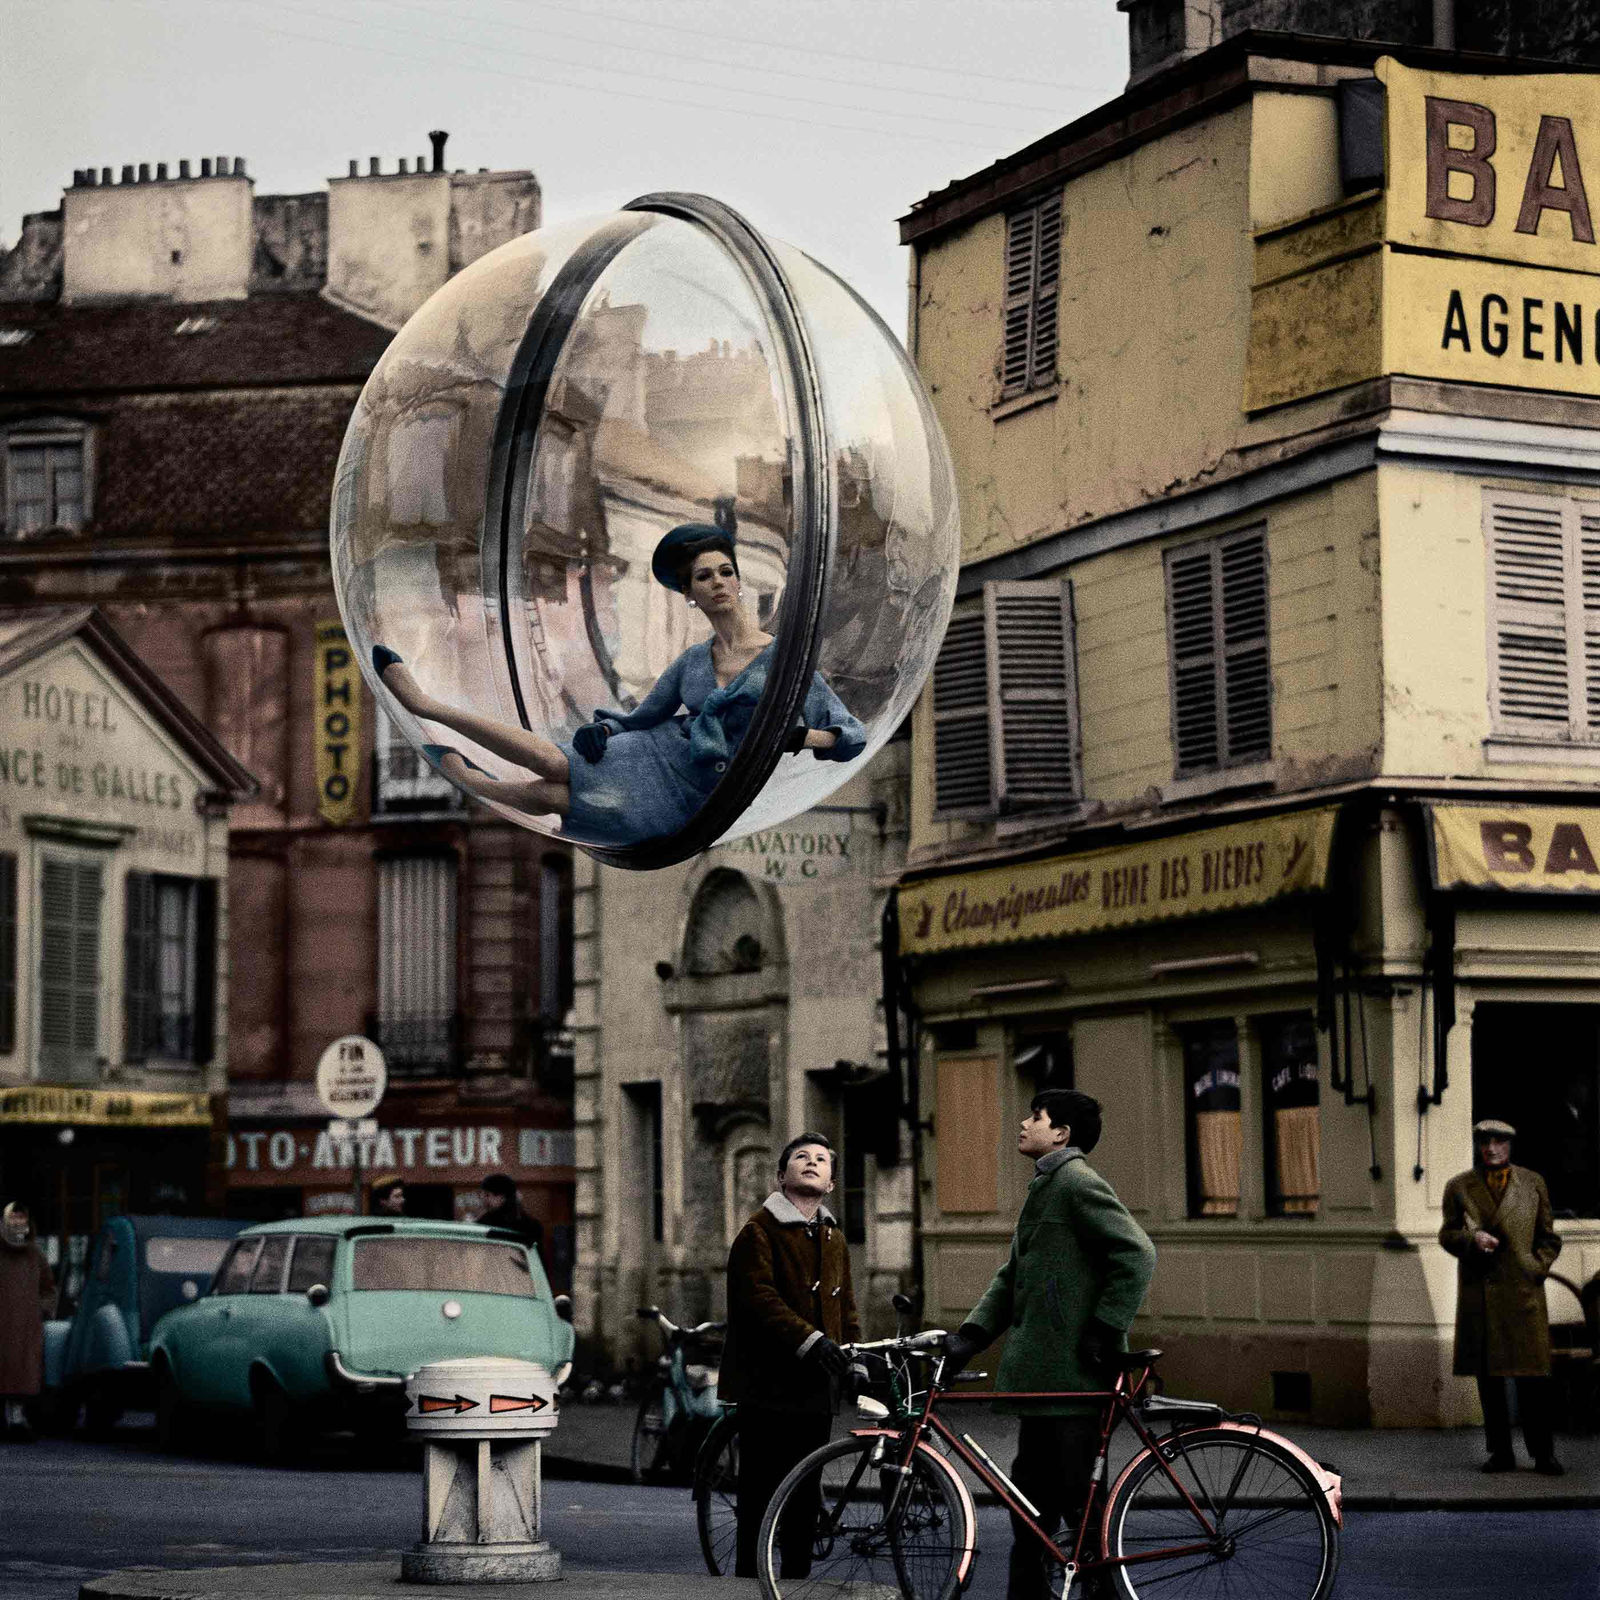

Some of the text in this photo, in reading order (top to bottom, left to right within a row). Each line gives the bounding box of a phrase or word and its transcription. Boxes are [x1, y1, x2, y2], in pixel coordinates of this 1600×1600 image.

[1425, 95, 1597, 245] BA
[1441, 289, 1600, 366] AGEN
[22, 681, 117, 733] HOTEL
[324, 648, 350, 801] PHOTO
[57, 761, 84, 794] DE
[93, 762, 182, 811] GALLES
[1480, 820, 1599, 874] BA
[1160, 855, 1190, 900] DES
